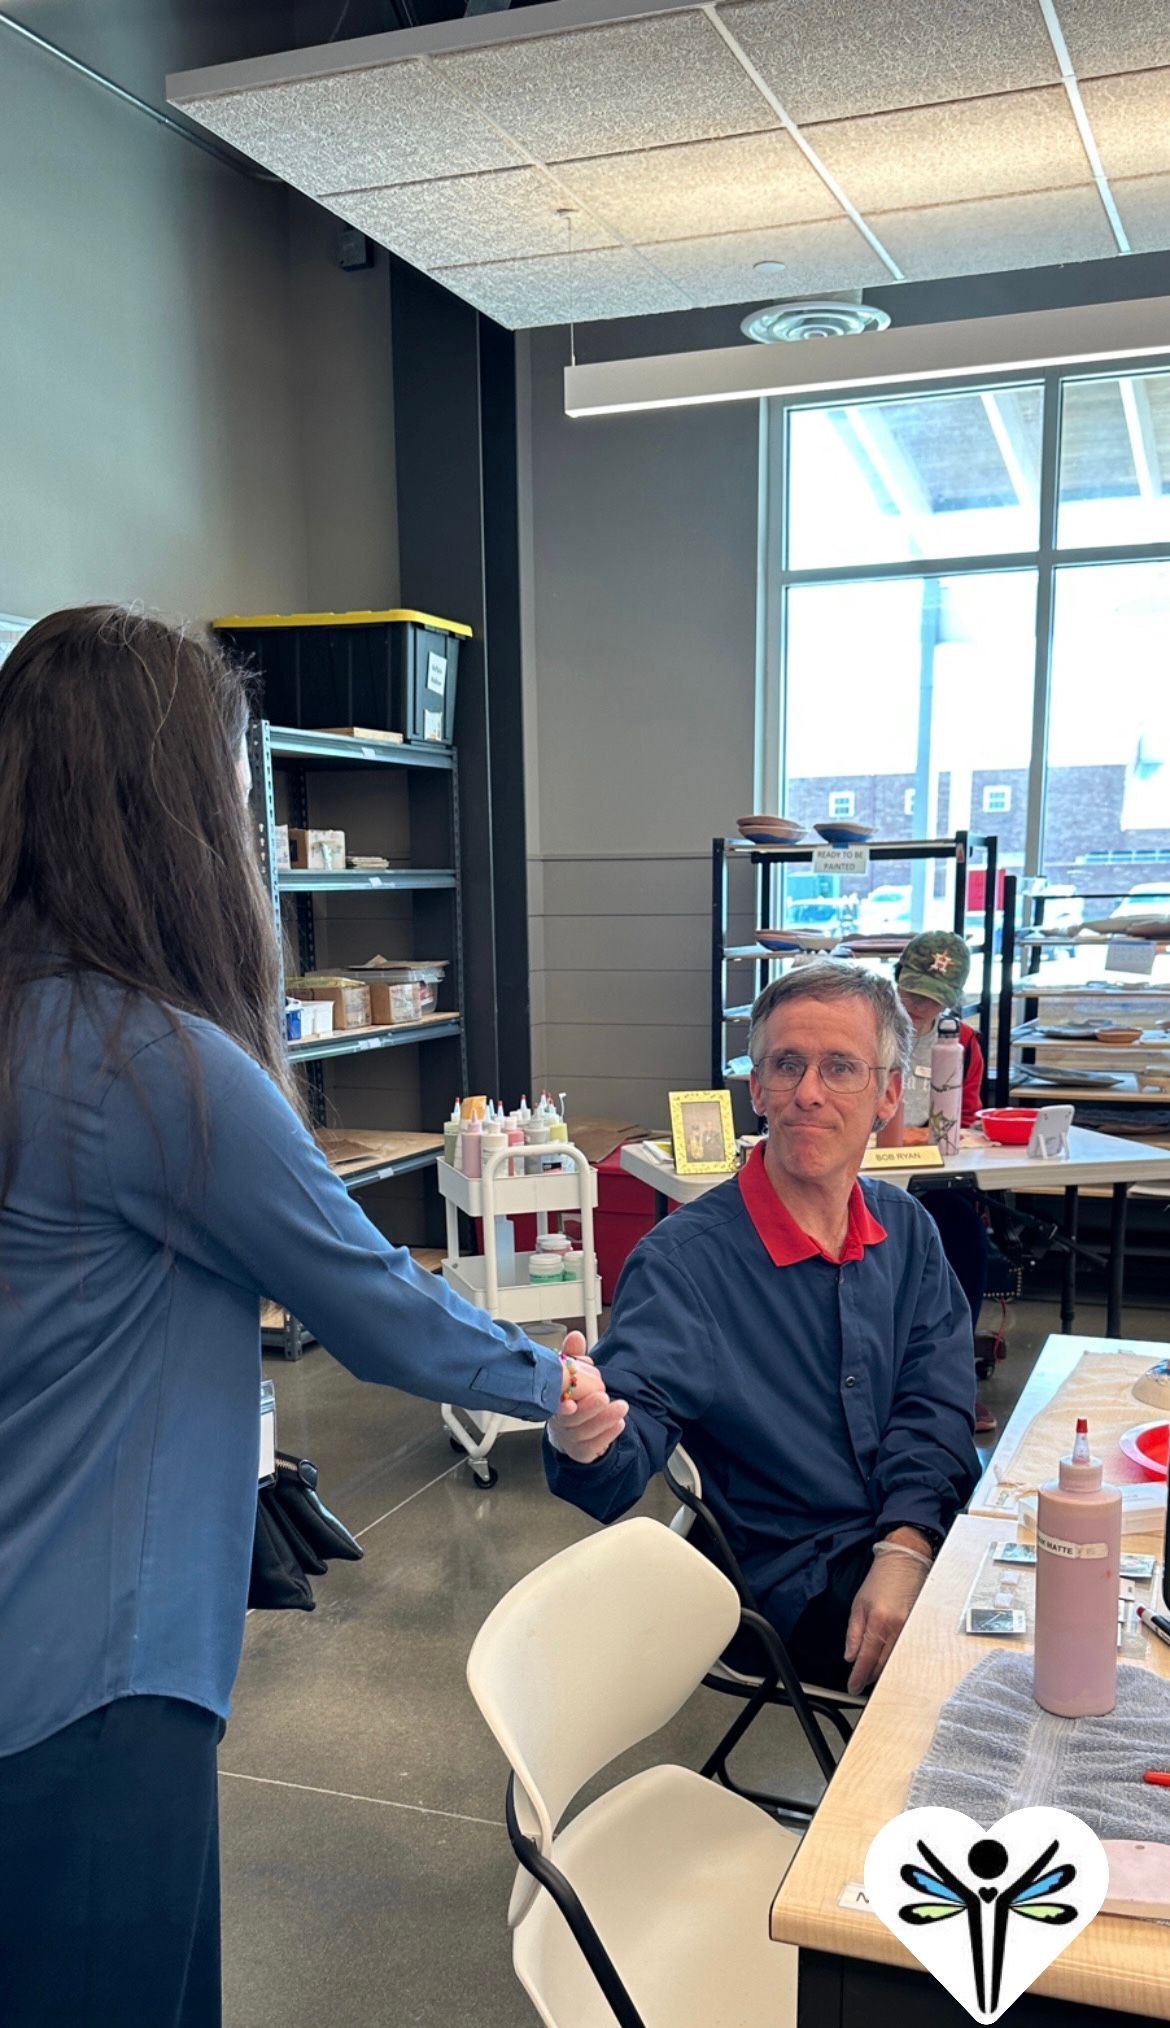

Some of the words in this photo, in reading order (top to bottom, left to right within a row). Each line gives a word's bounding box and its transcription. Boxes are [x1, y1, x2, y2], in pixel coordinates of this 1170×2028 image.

[817, 851, 841, 859] READY
[842, 851, 853, 859] TO
[854, 851, 864, 859] BE
[823, 863, 856, 871] PAINTED
[875, 1153, 896, 1161] BOB
[896, 1151, 921, 1160] RYAN
[1046, 1542, 1073, 1555] MATTE
